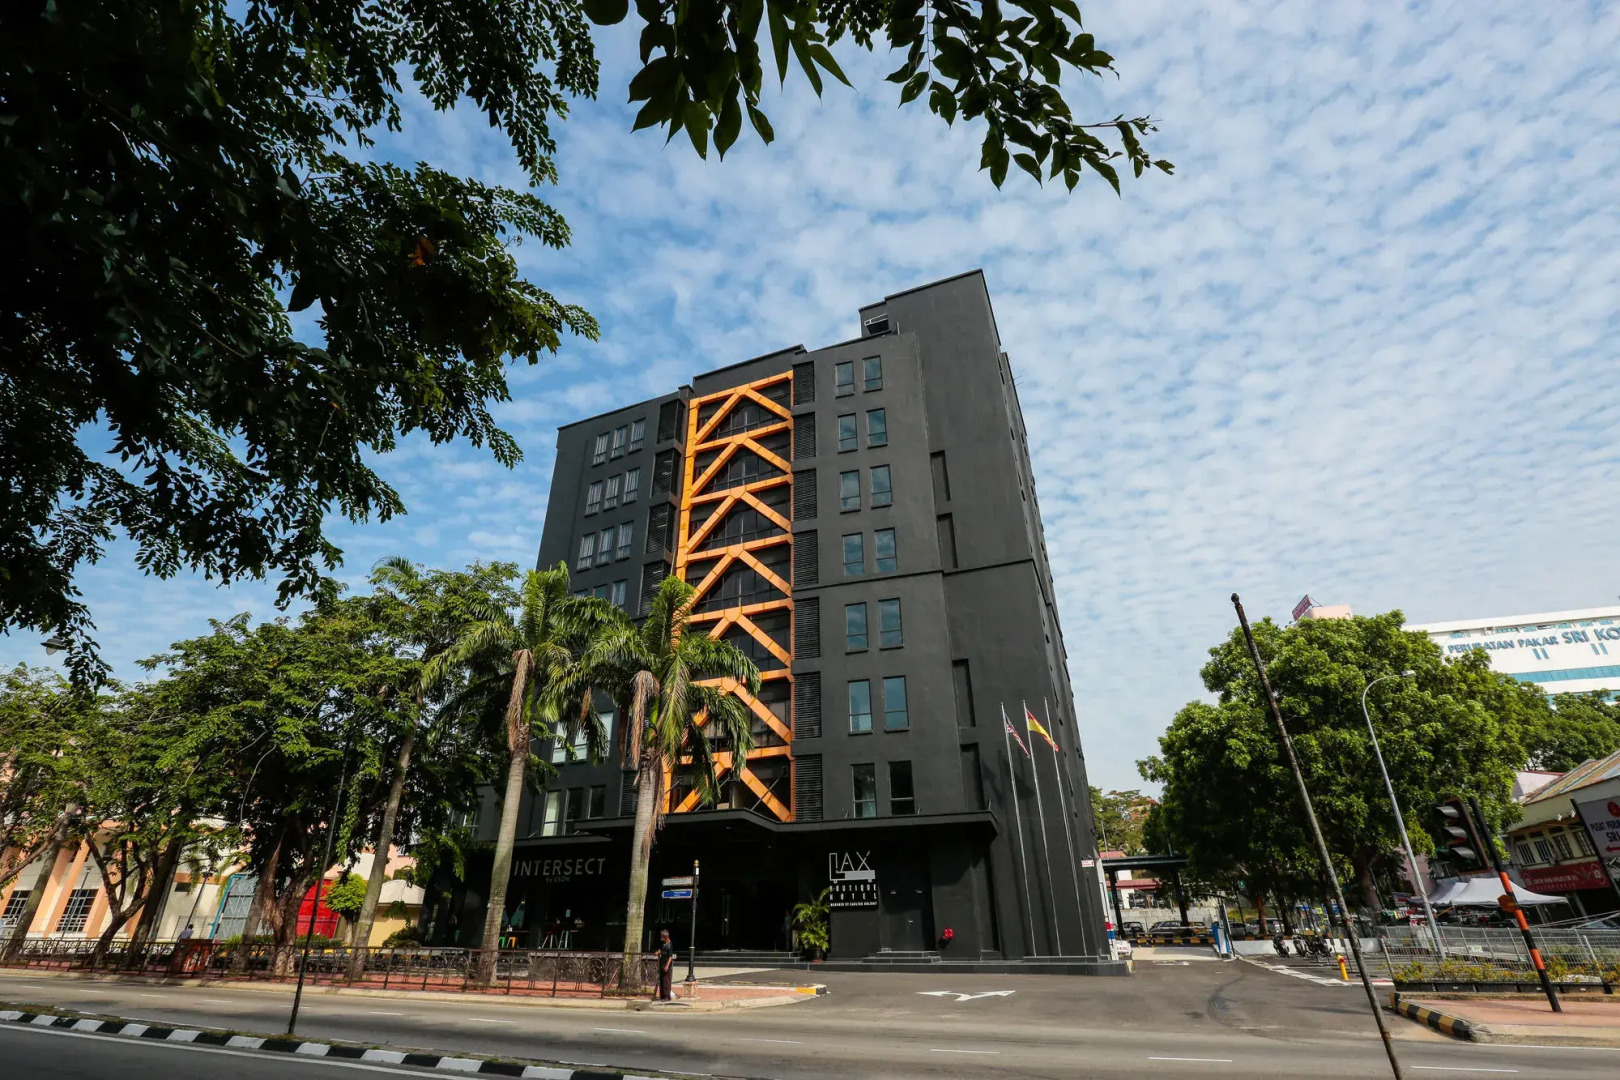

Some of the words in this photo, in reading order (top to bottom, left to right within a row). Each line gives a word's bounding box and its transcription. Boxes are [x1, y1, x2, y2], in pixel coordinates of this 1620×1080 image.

[1517, 636, 1559, 648] PAKAR
[1562, 630, 1590, 643] SRI
[1593, 626, 1620, 641] KO
[514, 858, 606, 876] INTERSECT
[829, 850, 876, 883] LAX
[829, 884, 877, 892] BOUTIQUE
